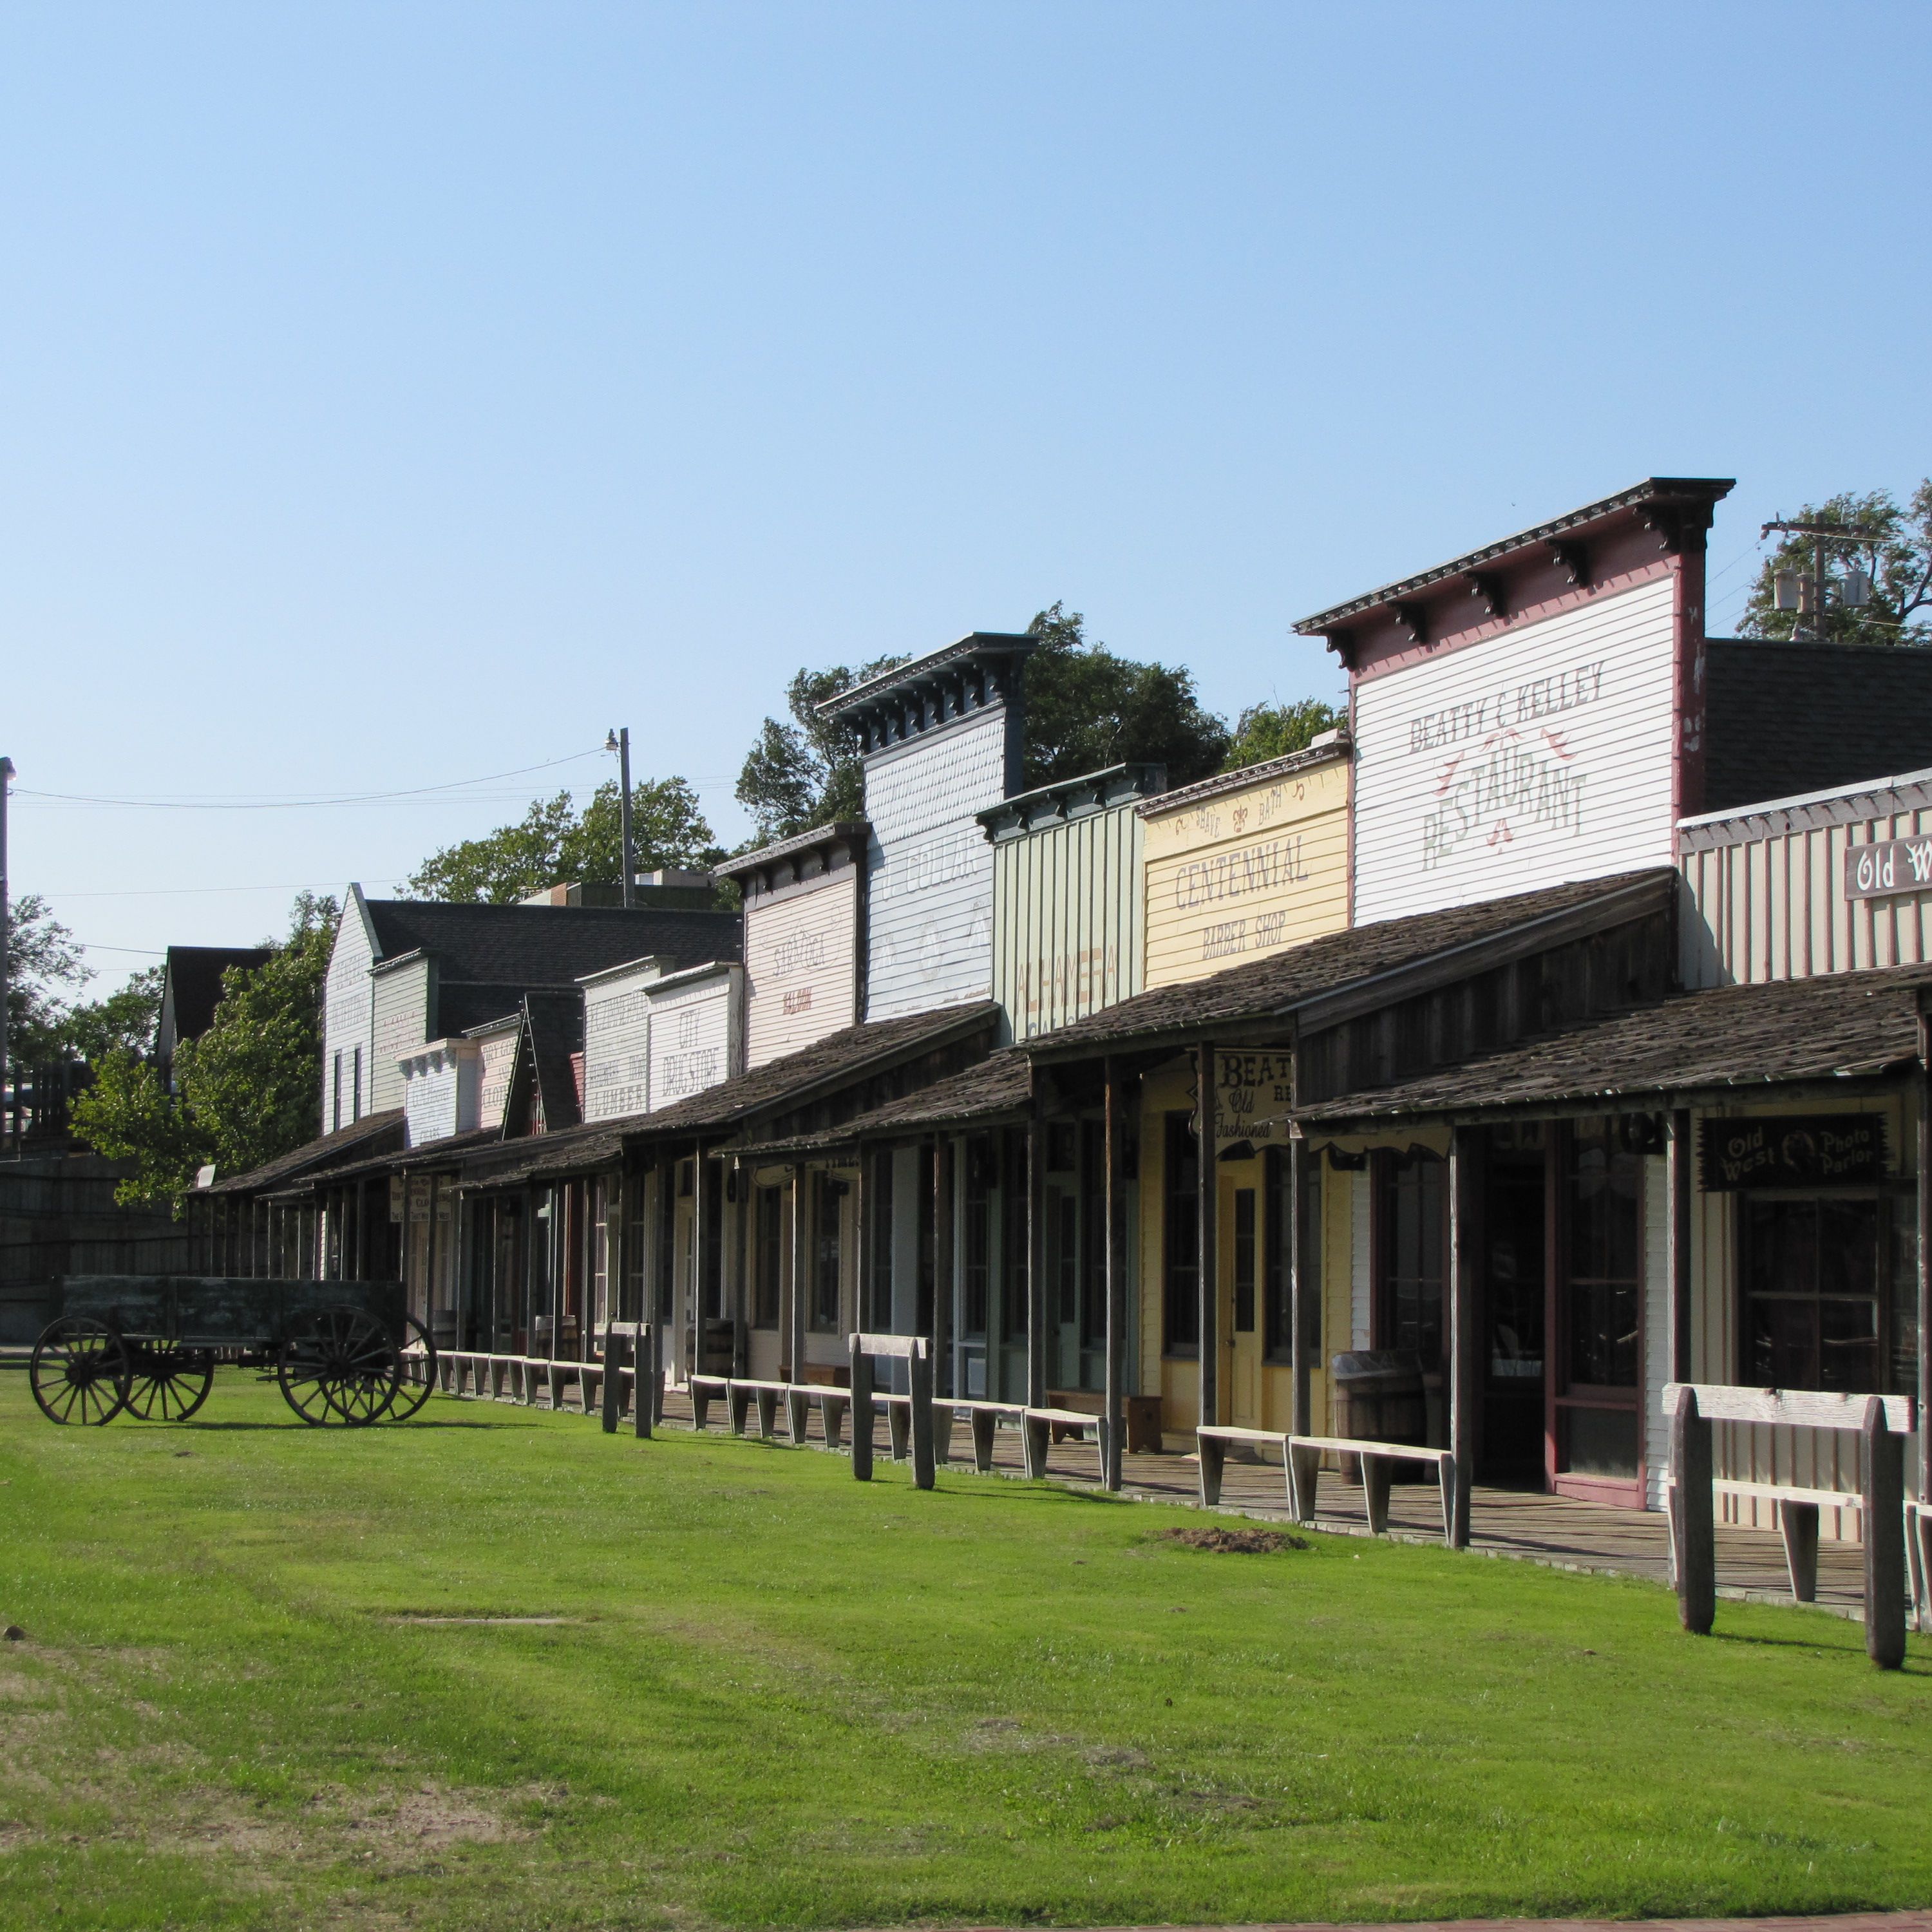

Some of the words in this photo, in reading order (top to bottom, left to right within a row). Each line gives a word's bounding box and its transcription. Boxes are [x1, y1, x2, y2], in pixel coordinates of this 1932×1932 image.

[1410, 698, 1488, 754] BEATTY
[1517, 660, 1605, 722] KELLEY
[1196, 806, 1221, 837] SHAVE
[1258, 784, 1282, 826] BATH
[1421, 744, 1587, 871] RESTAURANT
[1175, 835, 1309, 911] CENTENNIAL
[1857, 844, 1895, 891] Old
[1202, 918, 1246, 960] BARBER
[1255, 910, 1286, 949] SHOP
[1228, 1088, 1255, 1114] Old
[1213, 1112, 1271, 1139] Fashioned
[1728, 1126, 1764, 1159] Old
[1819, 1128, 1870, 1153] Photo
[1719, 1148, 1775, 1182] West
[1820, 1149, 1874, 1175] Parlor
